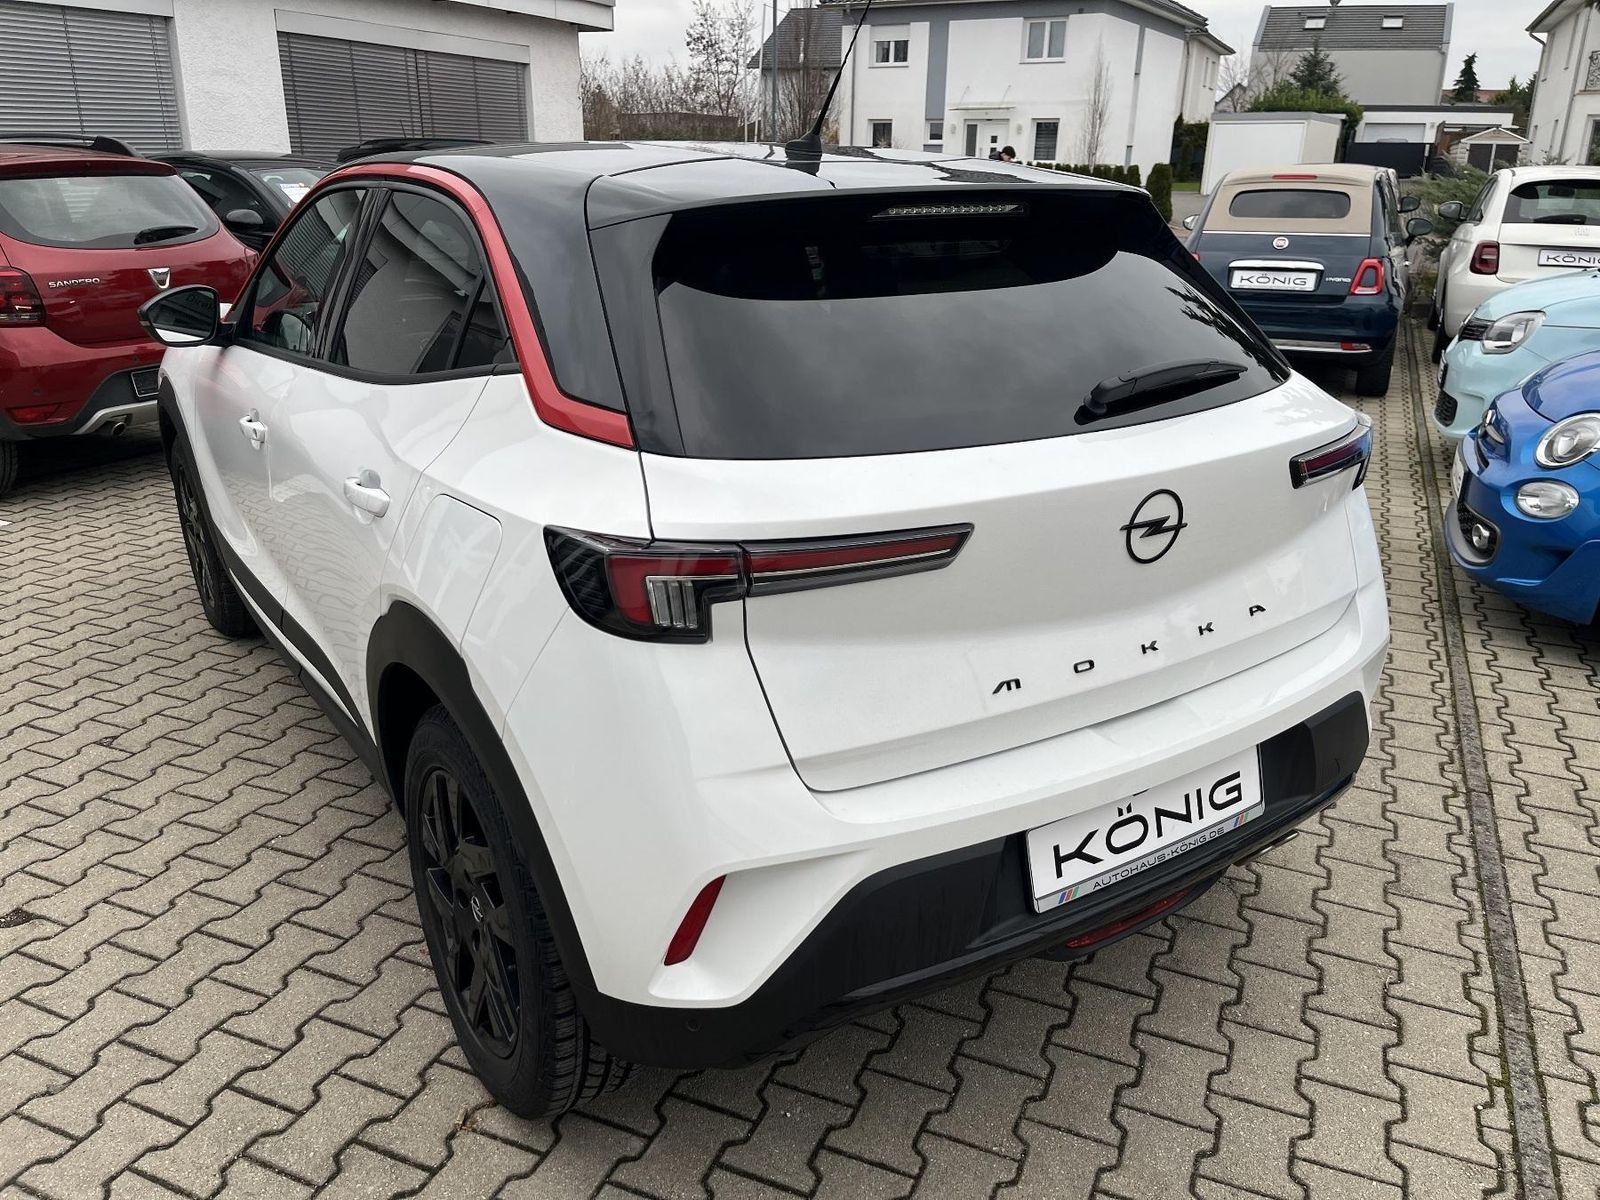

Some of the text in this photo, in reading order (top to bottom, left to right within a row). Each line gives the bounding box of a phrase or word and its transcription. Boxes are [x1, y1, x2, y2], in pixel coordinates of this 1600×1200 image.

[1239, 273, 1308, 286] KÖNIG
[1546, 252, 1600, 265] KÖNI
[992, 604, 1266, 695] MOKKA
[1053, 770, 1243, 879] KÖNIG
[1092, 826, 1225, 890] AUTOHAUS-KÖNIG.DE
